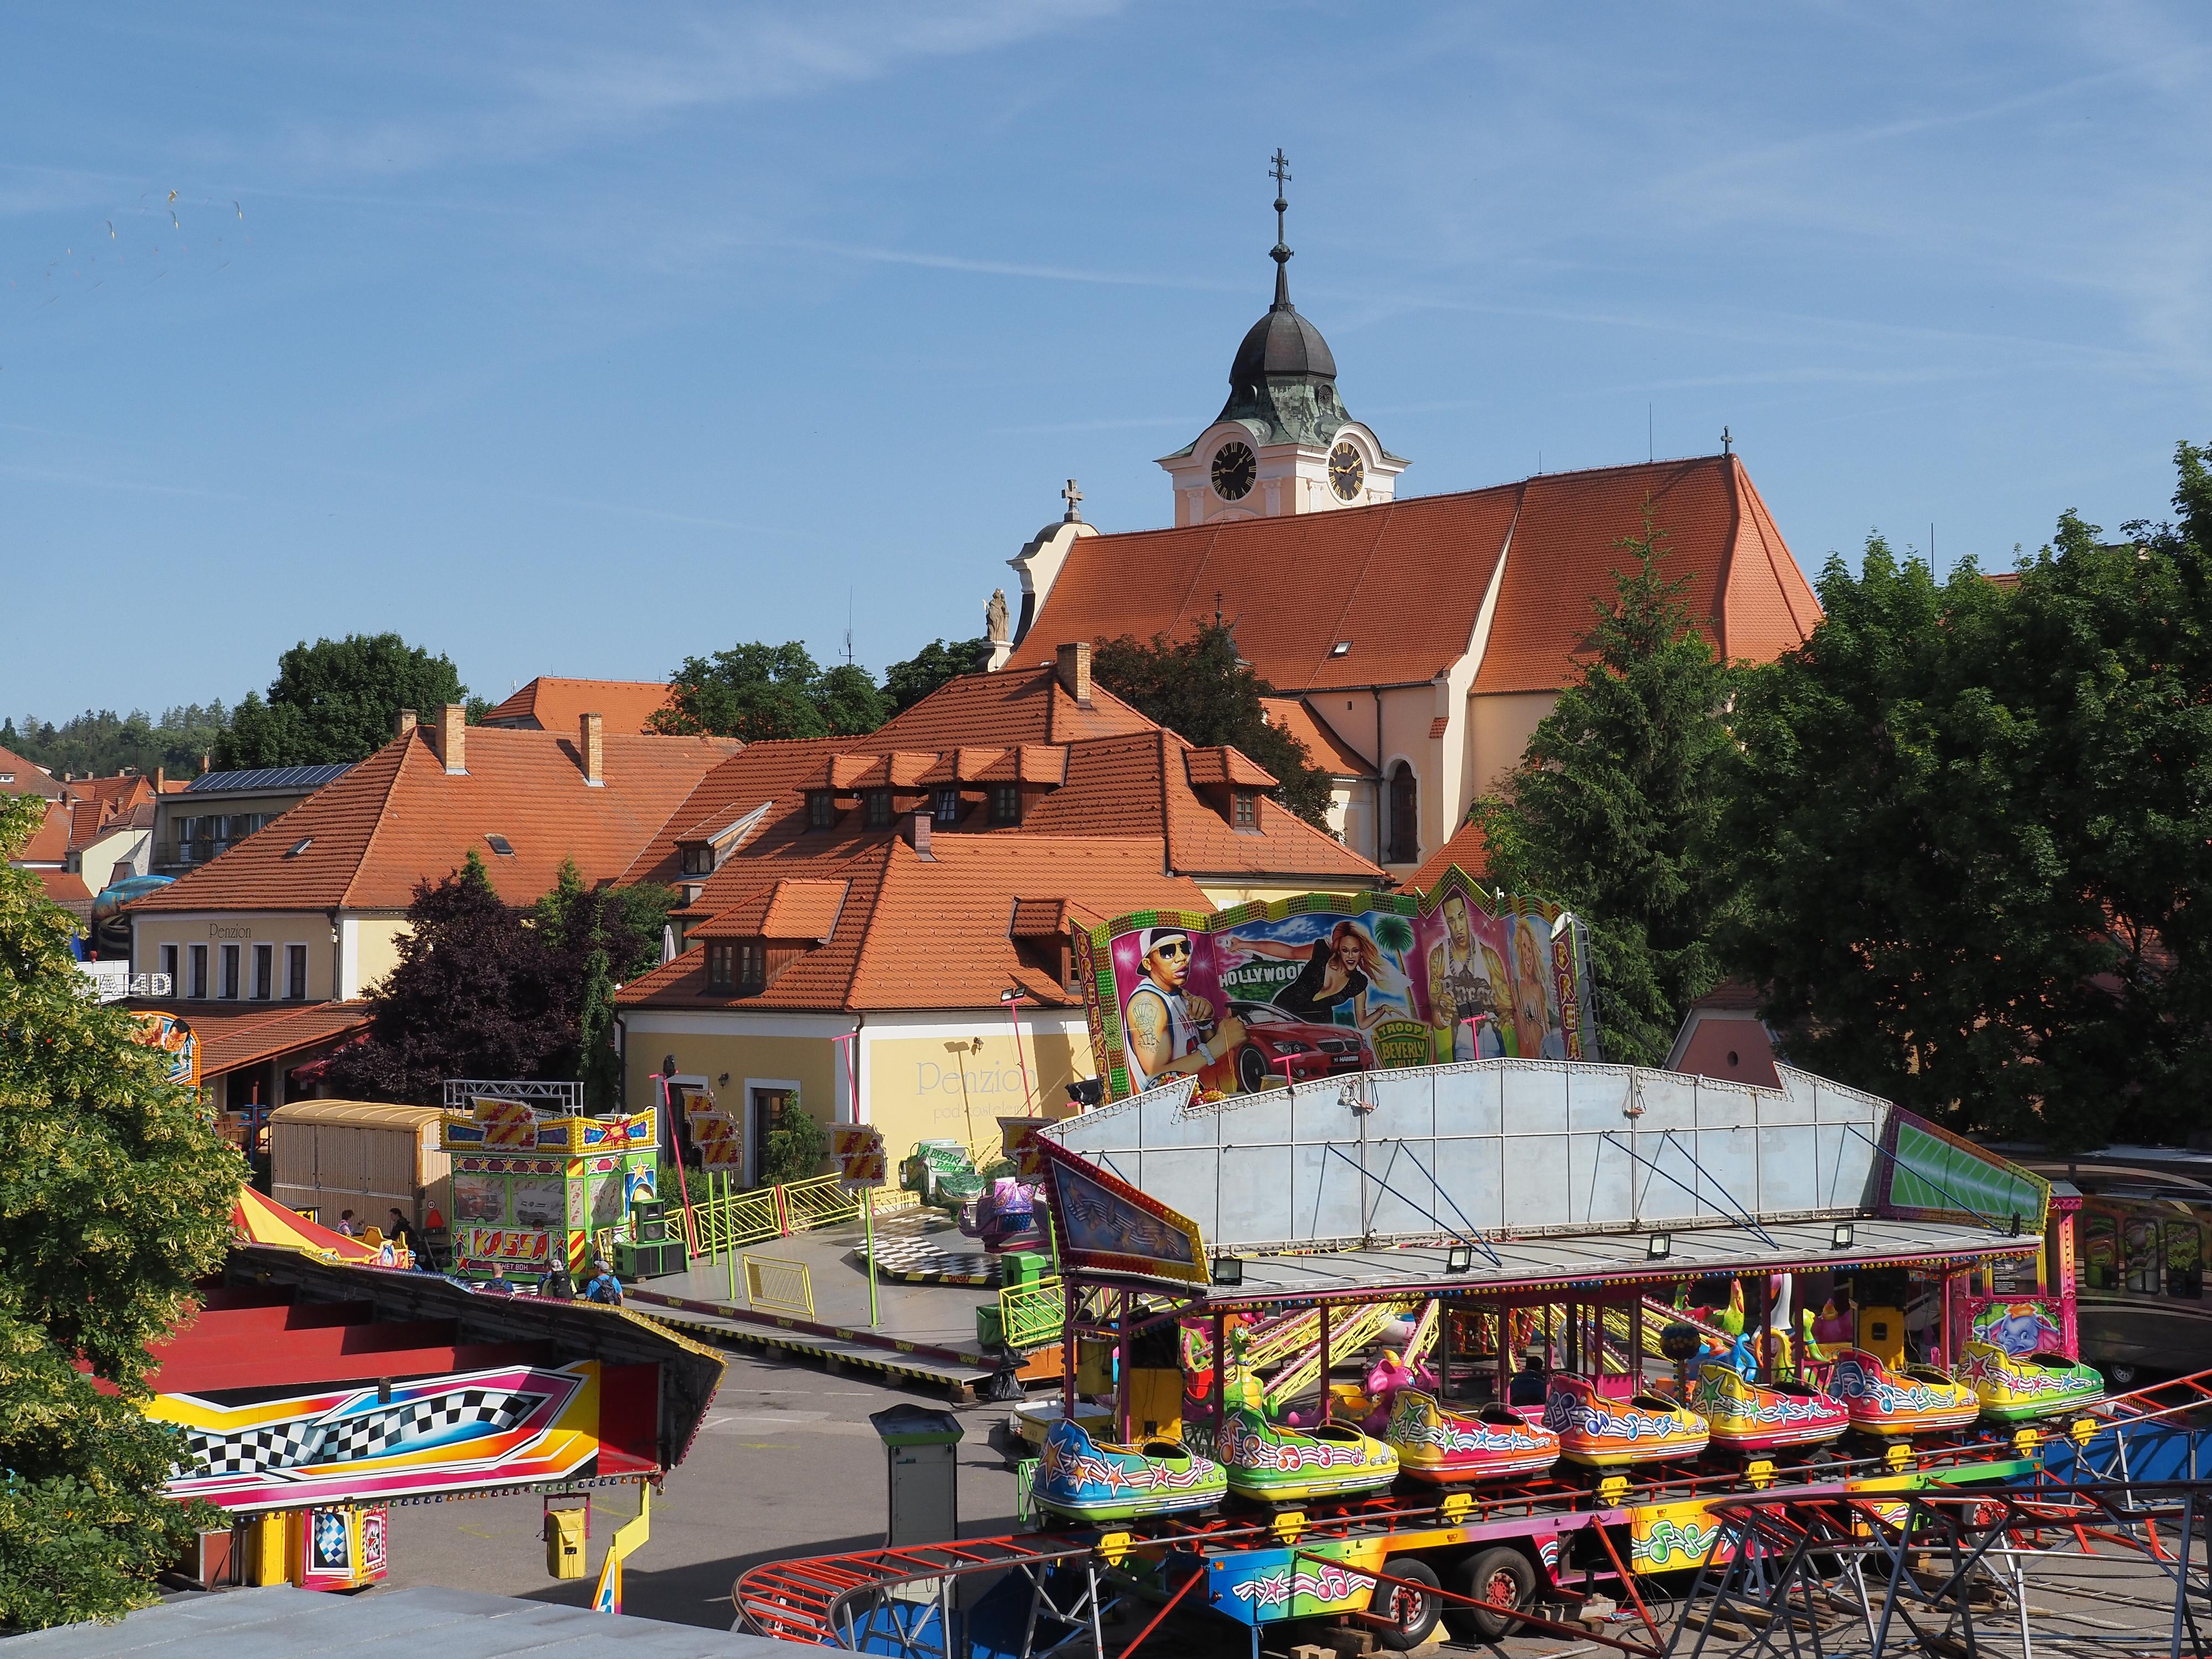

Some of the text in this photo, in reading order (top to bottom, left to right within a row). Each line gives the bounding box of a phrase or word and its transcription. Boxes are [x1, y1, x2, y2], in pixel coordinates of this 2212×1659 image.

[209, 923, 251, 938] Penzion
[130, 973, 171, 995] 4D
[1379, 1022, 1422, 1035] TROOP
[1381, 1041, 1425, 1060] BEVERLY
[916, 1061, 1038, 1095] Penzion
[934, 1102, 960, 1124] pod
[930, 1148, 961, 1164] BREAK
[474, 1229, 548, 1261] KASSA
